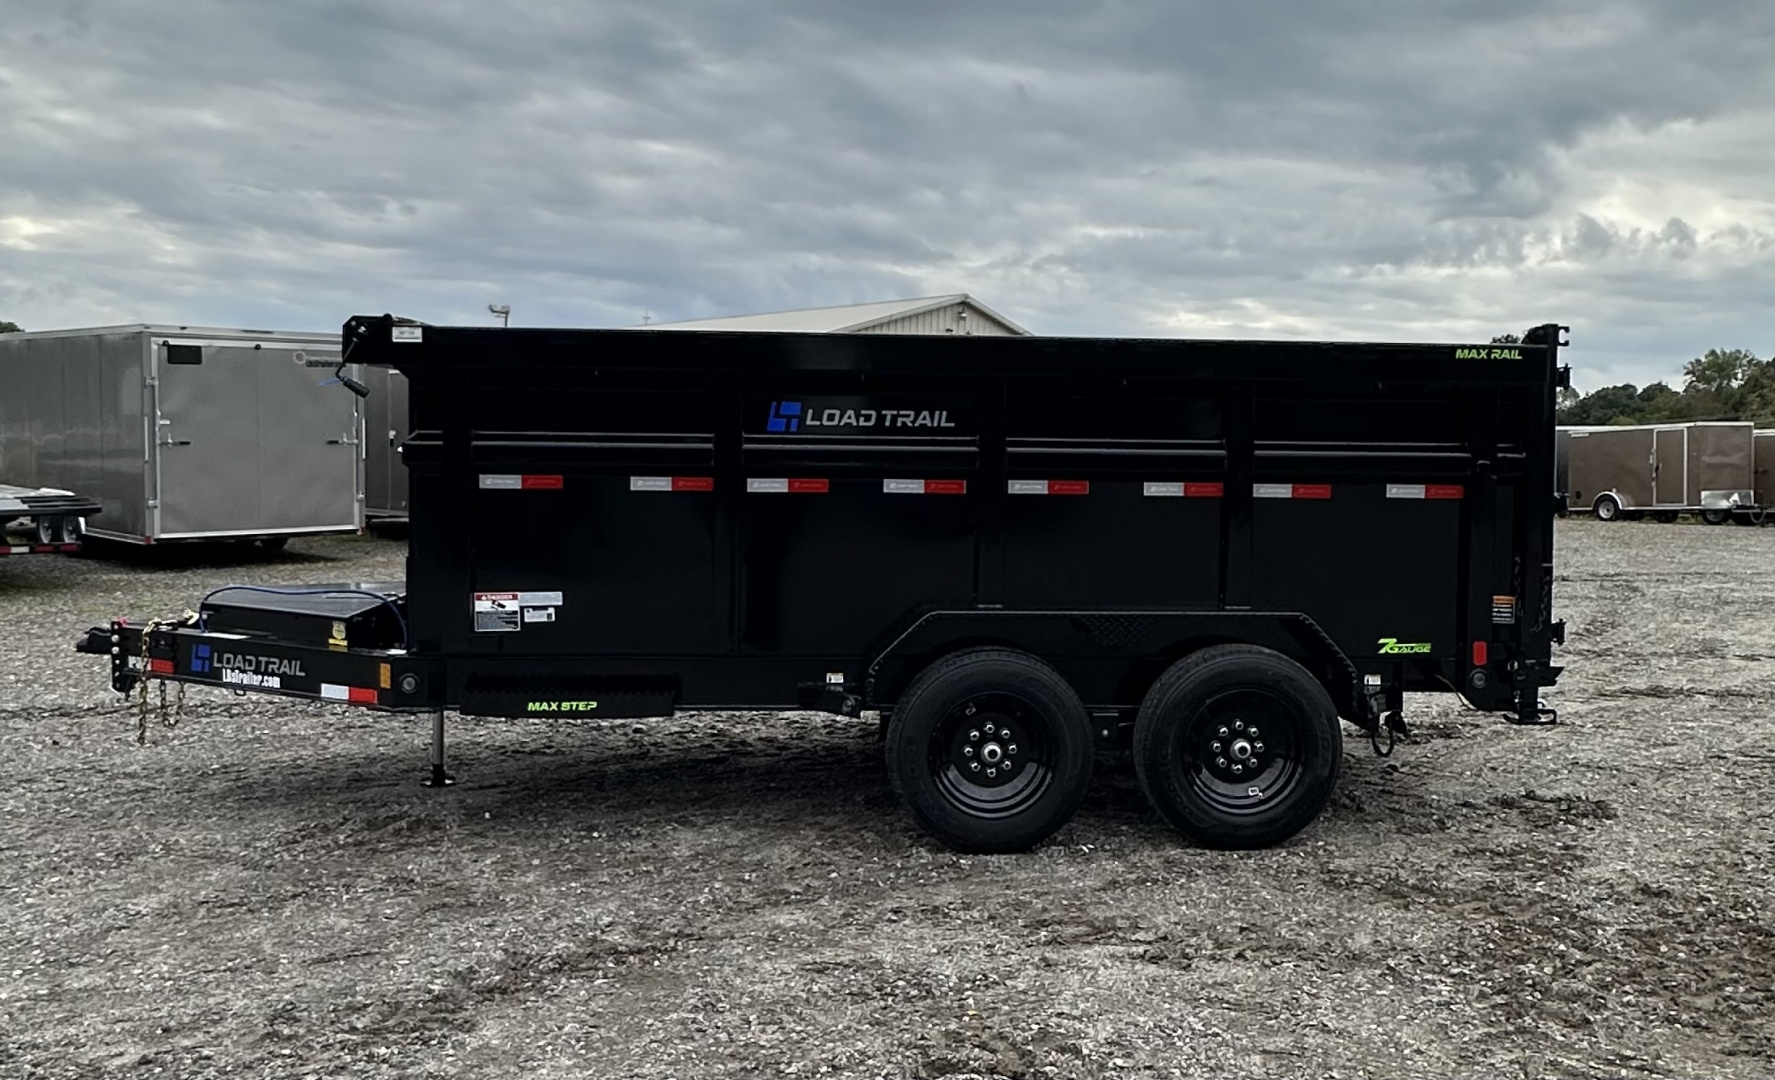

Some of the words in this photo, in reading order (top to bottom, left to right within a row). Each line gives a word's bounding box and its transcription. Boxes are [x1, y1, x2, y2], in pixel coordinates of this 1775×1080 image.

[1455, 348, 1489, 360] MAX
[1490, 348, 1523, 360] RAIL
[805, 409, 877, 426] LOAD
[881, 410, 955, 427] TRAIL
[213, 652, 256, 671] LOAD
[258, 656, 306, 677] TRAIL
[527, 701, 559, 711] MAX
[560, 701, 598, 711] STEP
